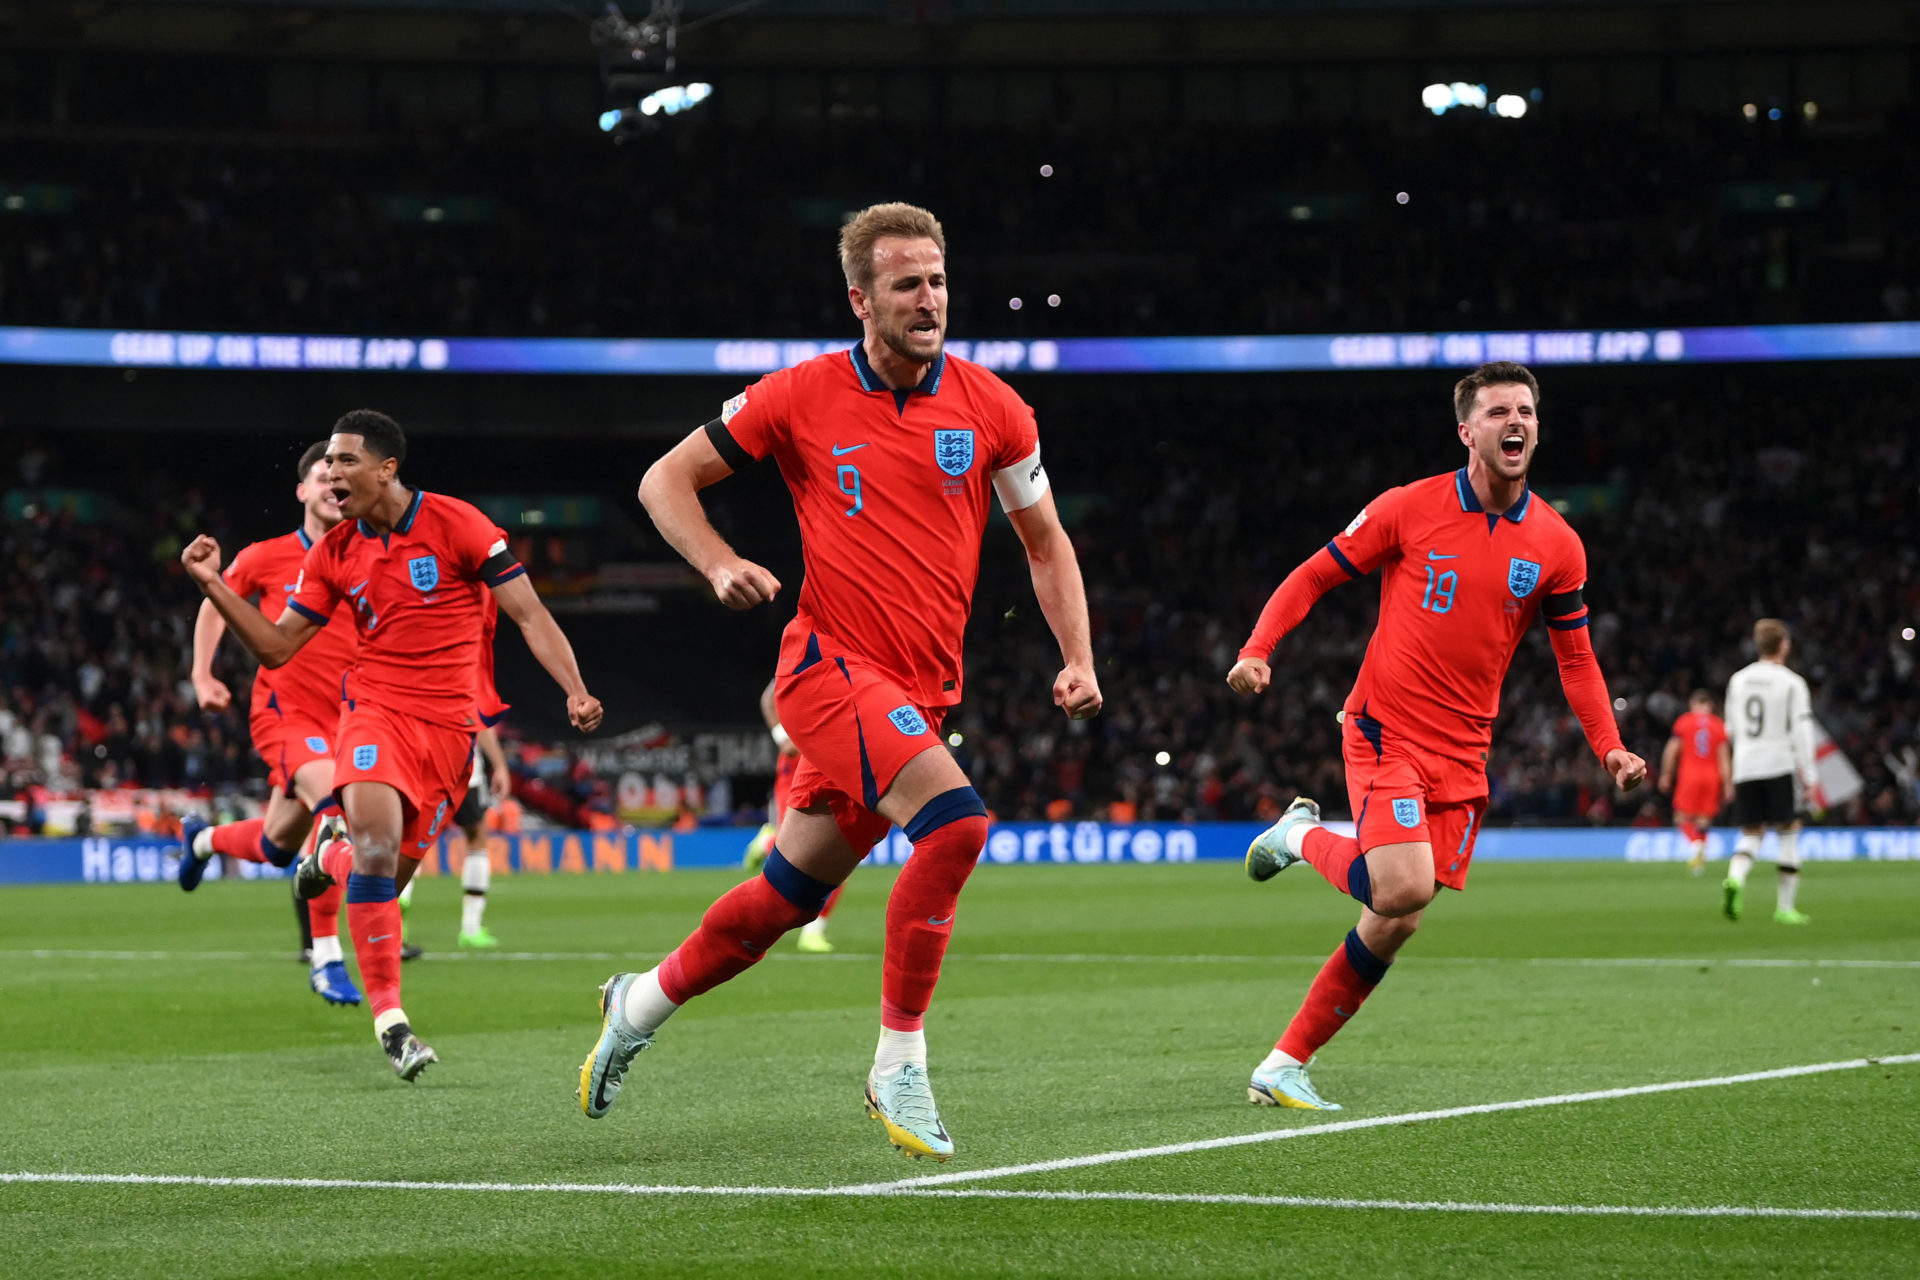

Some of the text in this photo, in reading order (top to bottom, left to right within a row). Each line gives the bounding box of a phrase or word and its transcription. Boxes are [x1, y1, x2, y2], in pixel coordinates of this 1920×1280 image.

[111, 332, 416, 369] GEAR UP ON THE NIKE APP
[714, 340, 779, 372] GEAR
[973, 340, 1026, 371] APP
[1330, 330, 1650, 368] GEAR UP ON THE NIKE APP
[837, 464, 863, 517] 9
[1421, 564, 1458, 614] 19
[1745, 694, 1765, 739] 9
[1797, 831, 1855, 862] ON
